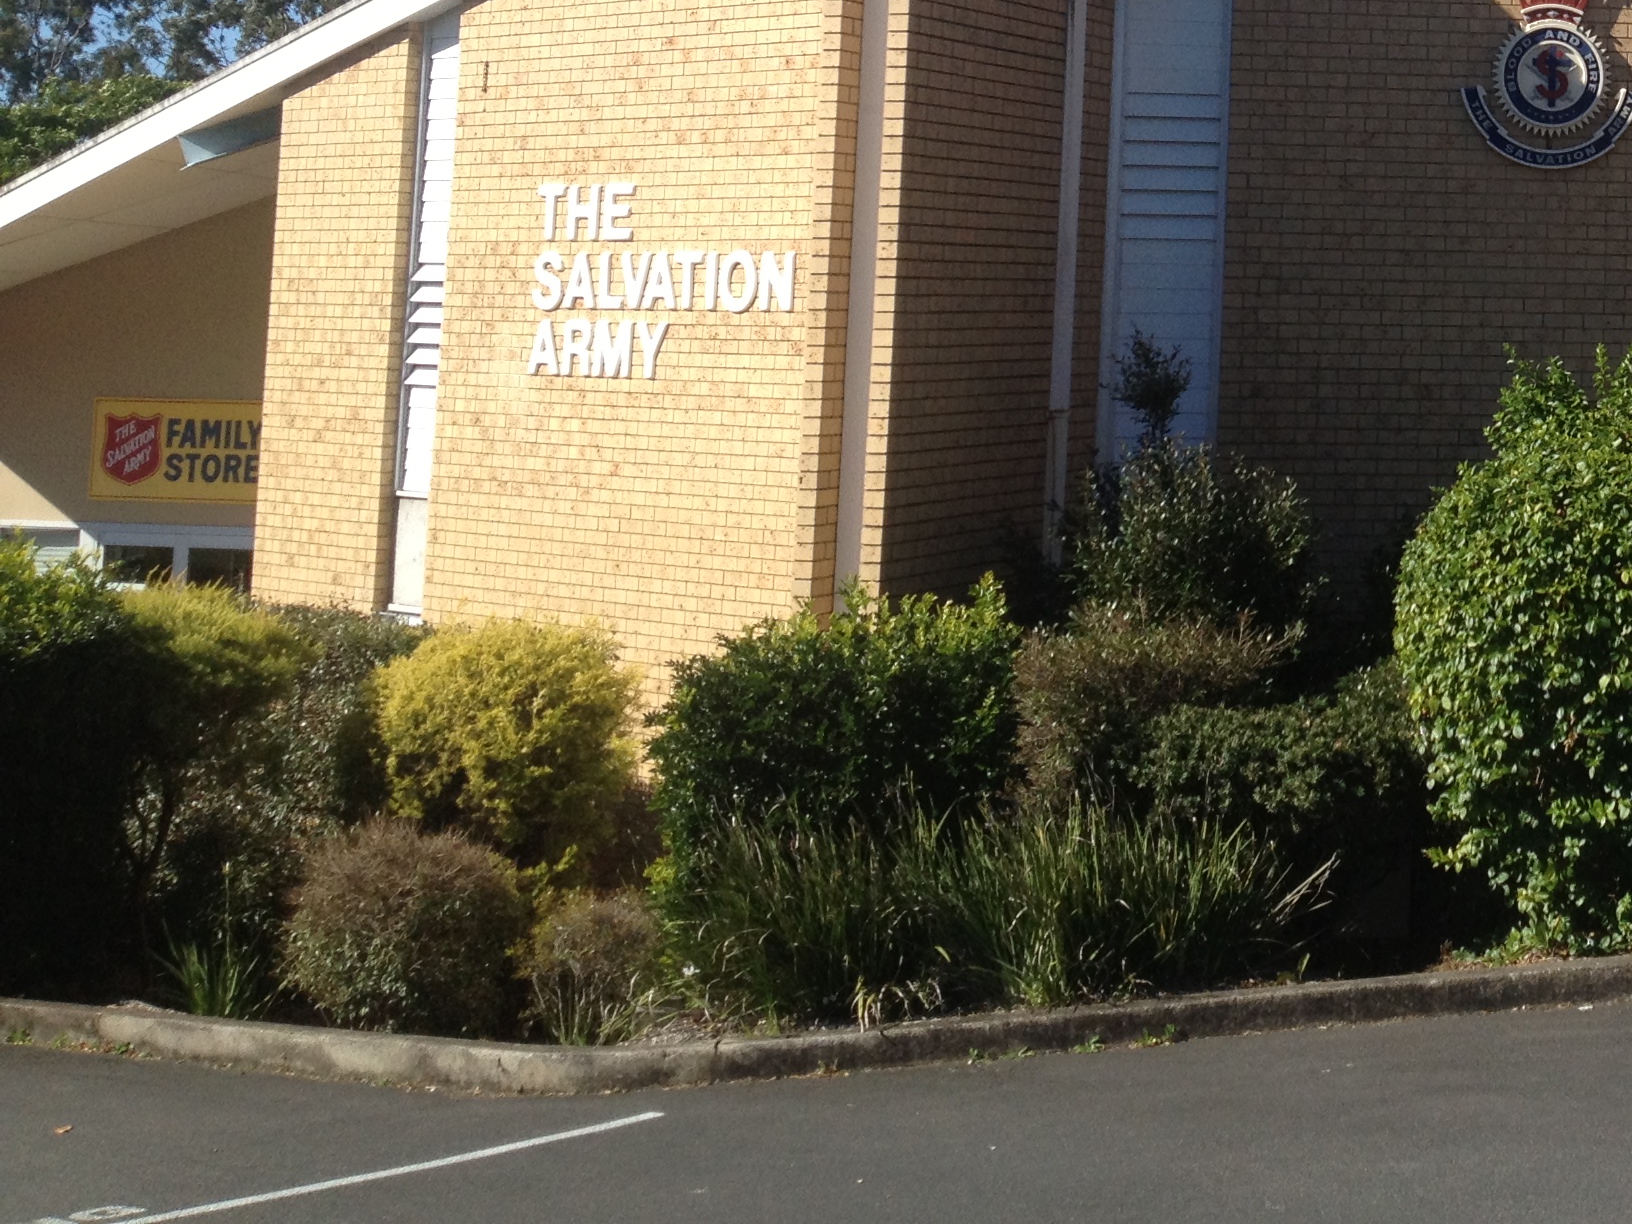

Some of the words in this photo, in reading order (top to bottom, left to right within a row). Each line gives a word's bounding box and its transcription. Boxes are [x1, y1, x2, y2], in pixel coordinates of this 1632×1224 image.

[1506, 38, 1532, 92] BLOOD
[1544, 30, 1580, 46] AND
[1584, 53, 1598, 94] FIRE
[1471, 99, 1493, 130] THE
[1504, 144, 1596, 165] SALVATION
[538, 182, 636, 241] THE
[531, 249, 796, 314] SALVATION
[527, 317, 669, 379] ARMY
[105, 425, 157, 469] SALVATION
[115, 420, 138, 443] THE
[166, 418, 261, 449] FAMILY
[122, 446, 152, 476] ARMY
[163, 453, 258, 484] STORE
